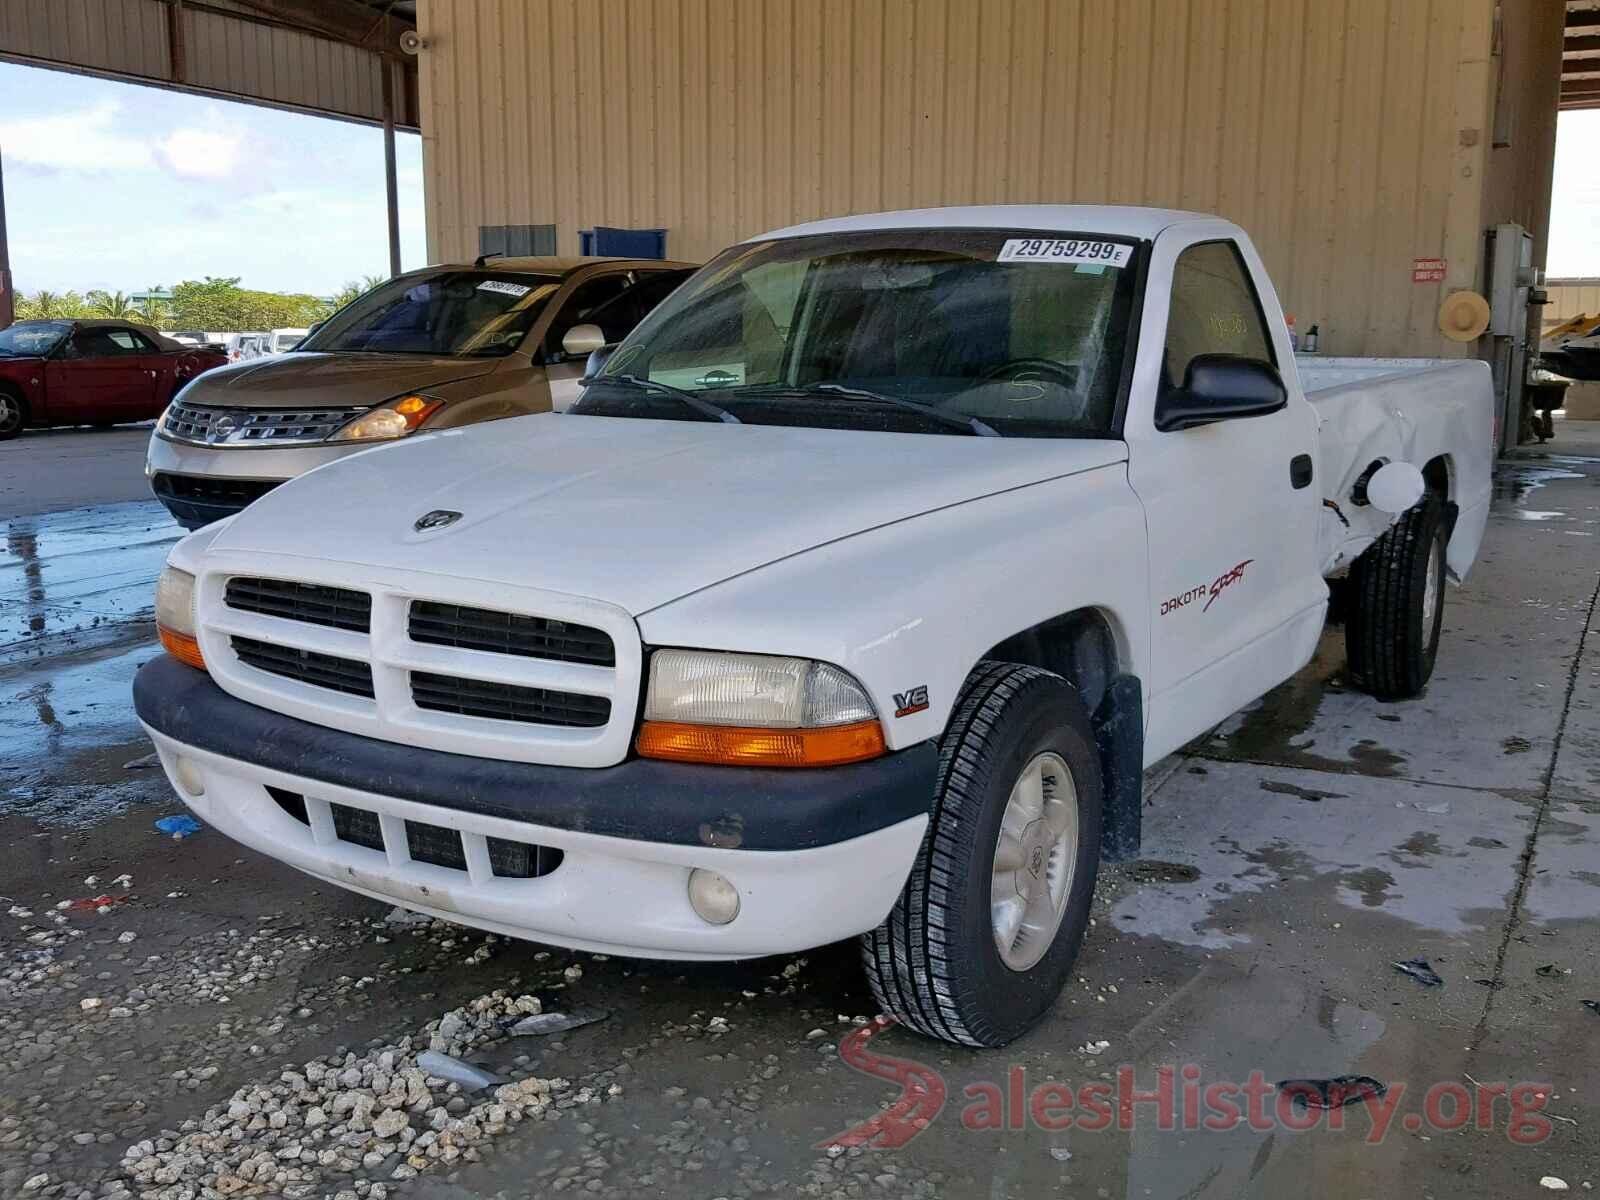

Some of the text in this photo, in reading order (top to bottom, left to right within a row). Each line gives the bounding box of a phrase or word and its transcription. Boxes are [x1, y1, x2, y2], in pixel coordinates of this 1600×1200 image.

[1015, 240, 1115, 260] 29759299
[1160, 584, 1206, 616] DAKOTA
[893, 684, 929, 710] V6
